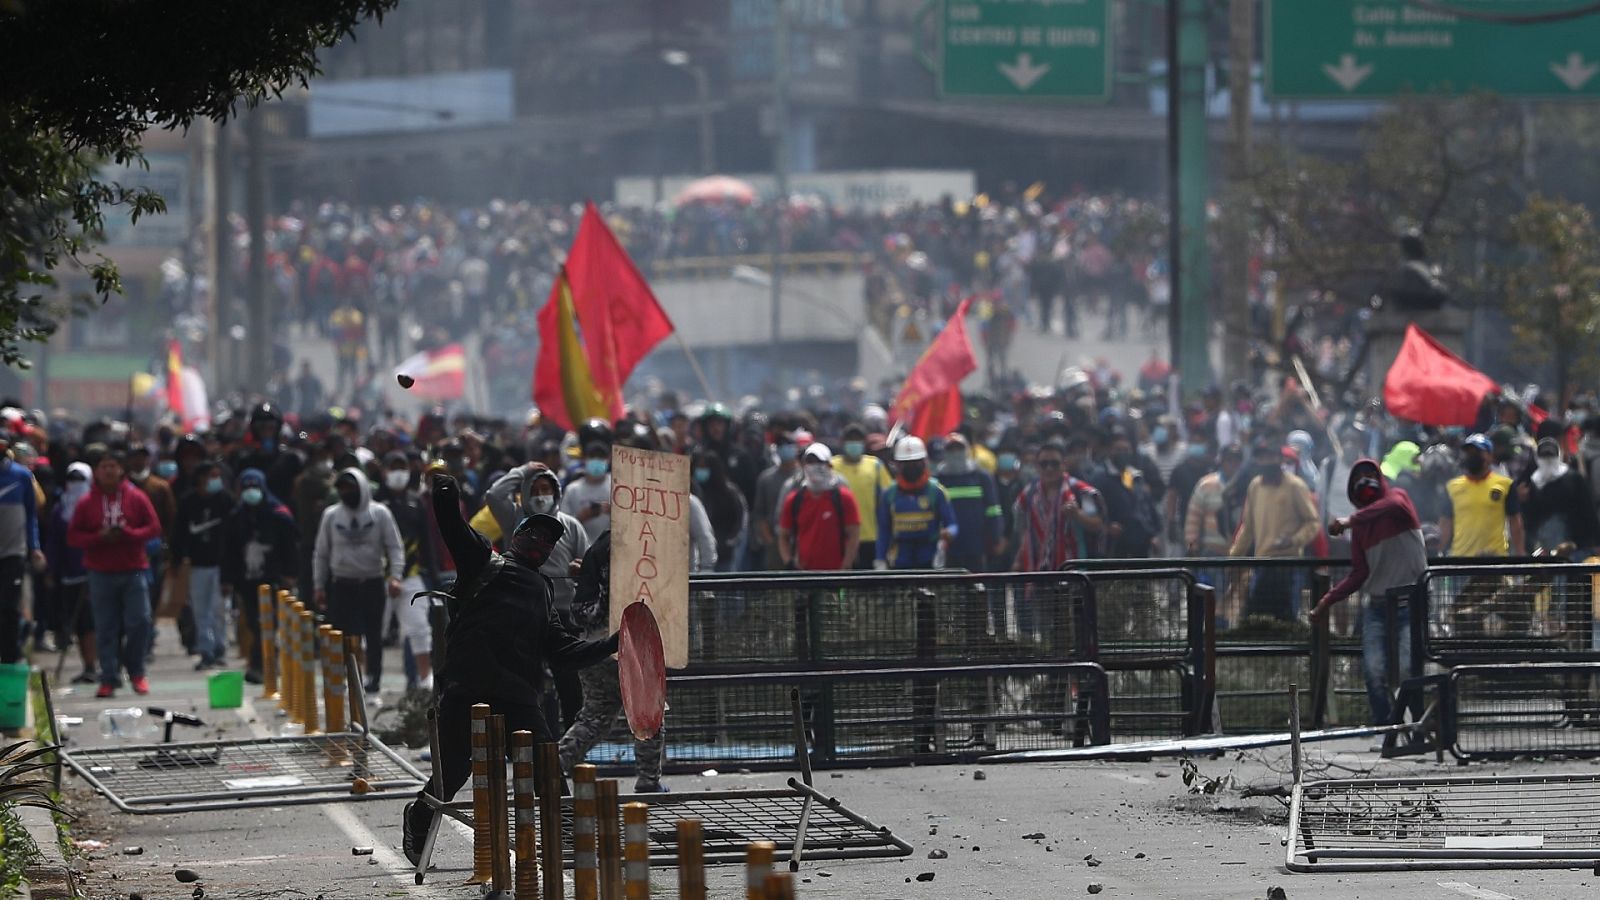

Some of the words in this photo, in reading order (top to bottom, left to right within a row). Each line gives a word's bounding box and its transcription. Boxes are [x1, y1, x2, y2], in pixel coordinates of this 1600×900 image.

[950, 27, 1015, 46] CENTRO
[1020, 27, 1042, 46] DE
[1046, 27, 1099, 47] QUITO
